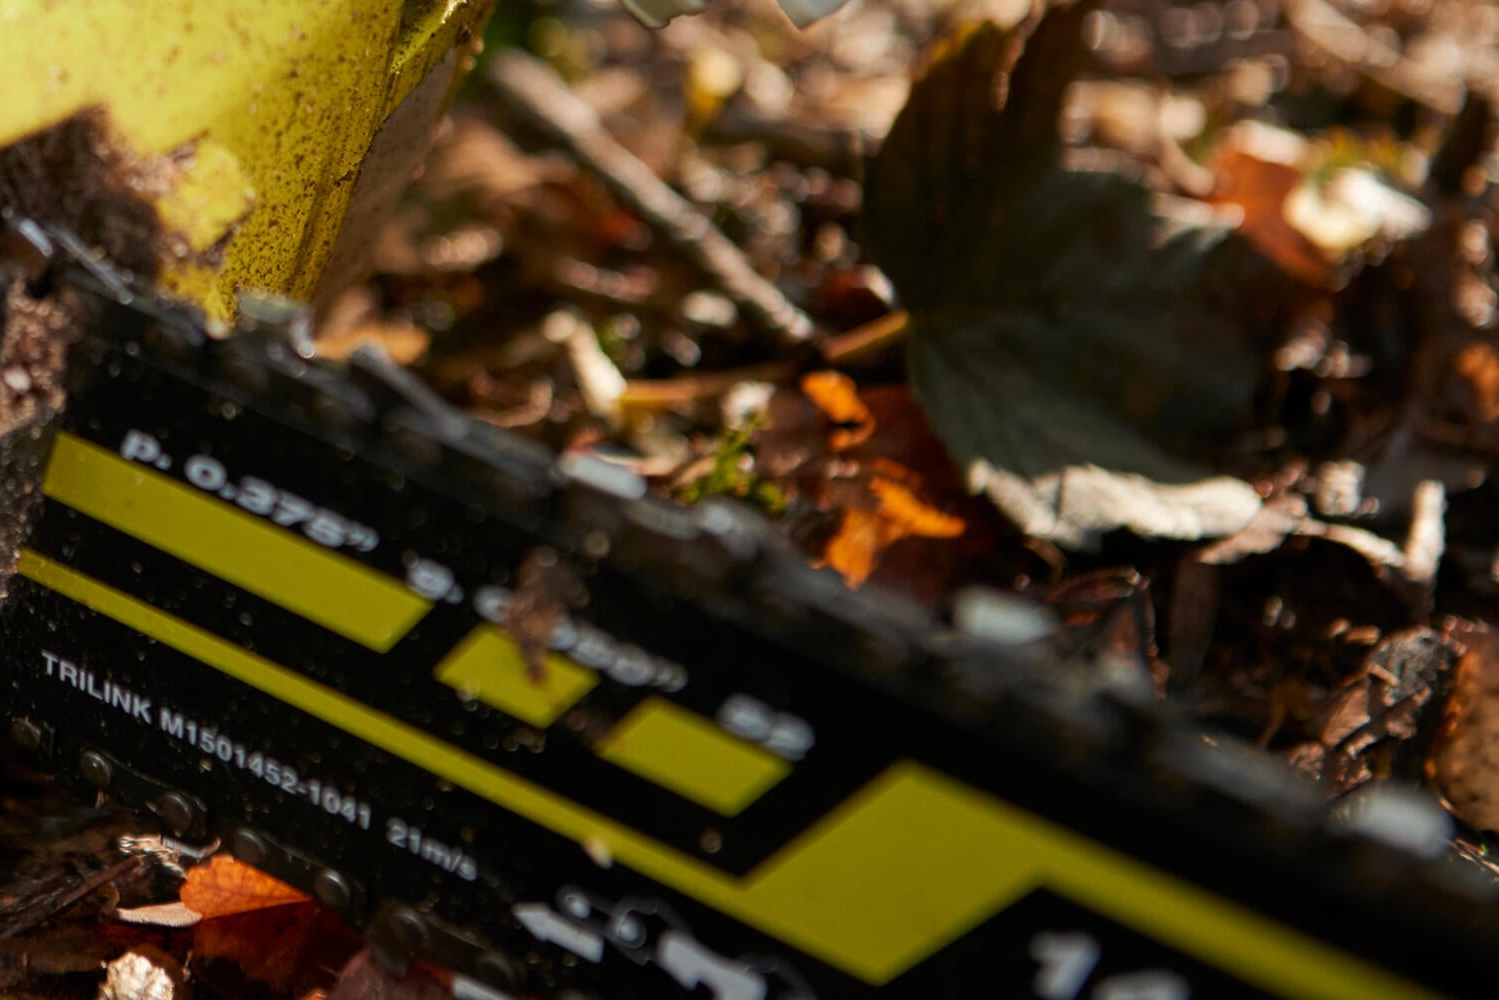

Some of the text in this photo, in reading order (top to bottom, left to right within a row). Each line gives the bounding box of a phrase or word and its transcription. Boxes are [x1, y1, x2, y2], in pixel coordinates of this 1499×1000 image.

[41, 650, 479, 882] TRILINK M1501452-1041 21m/s
